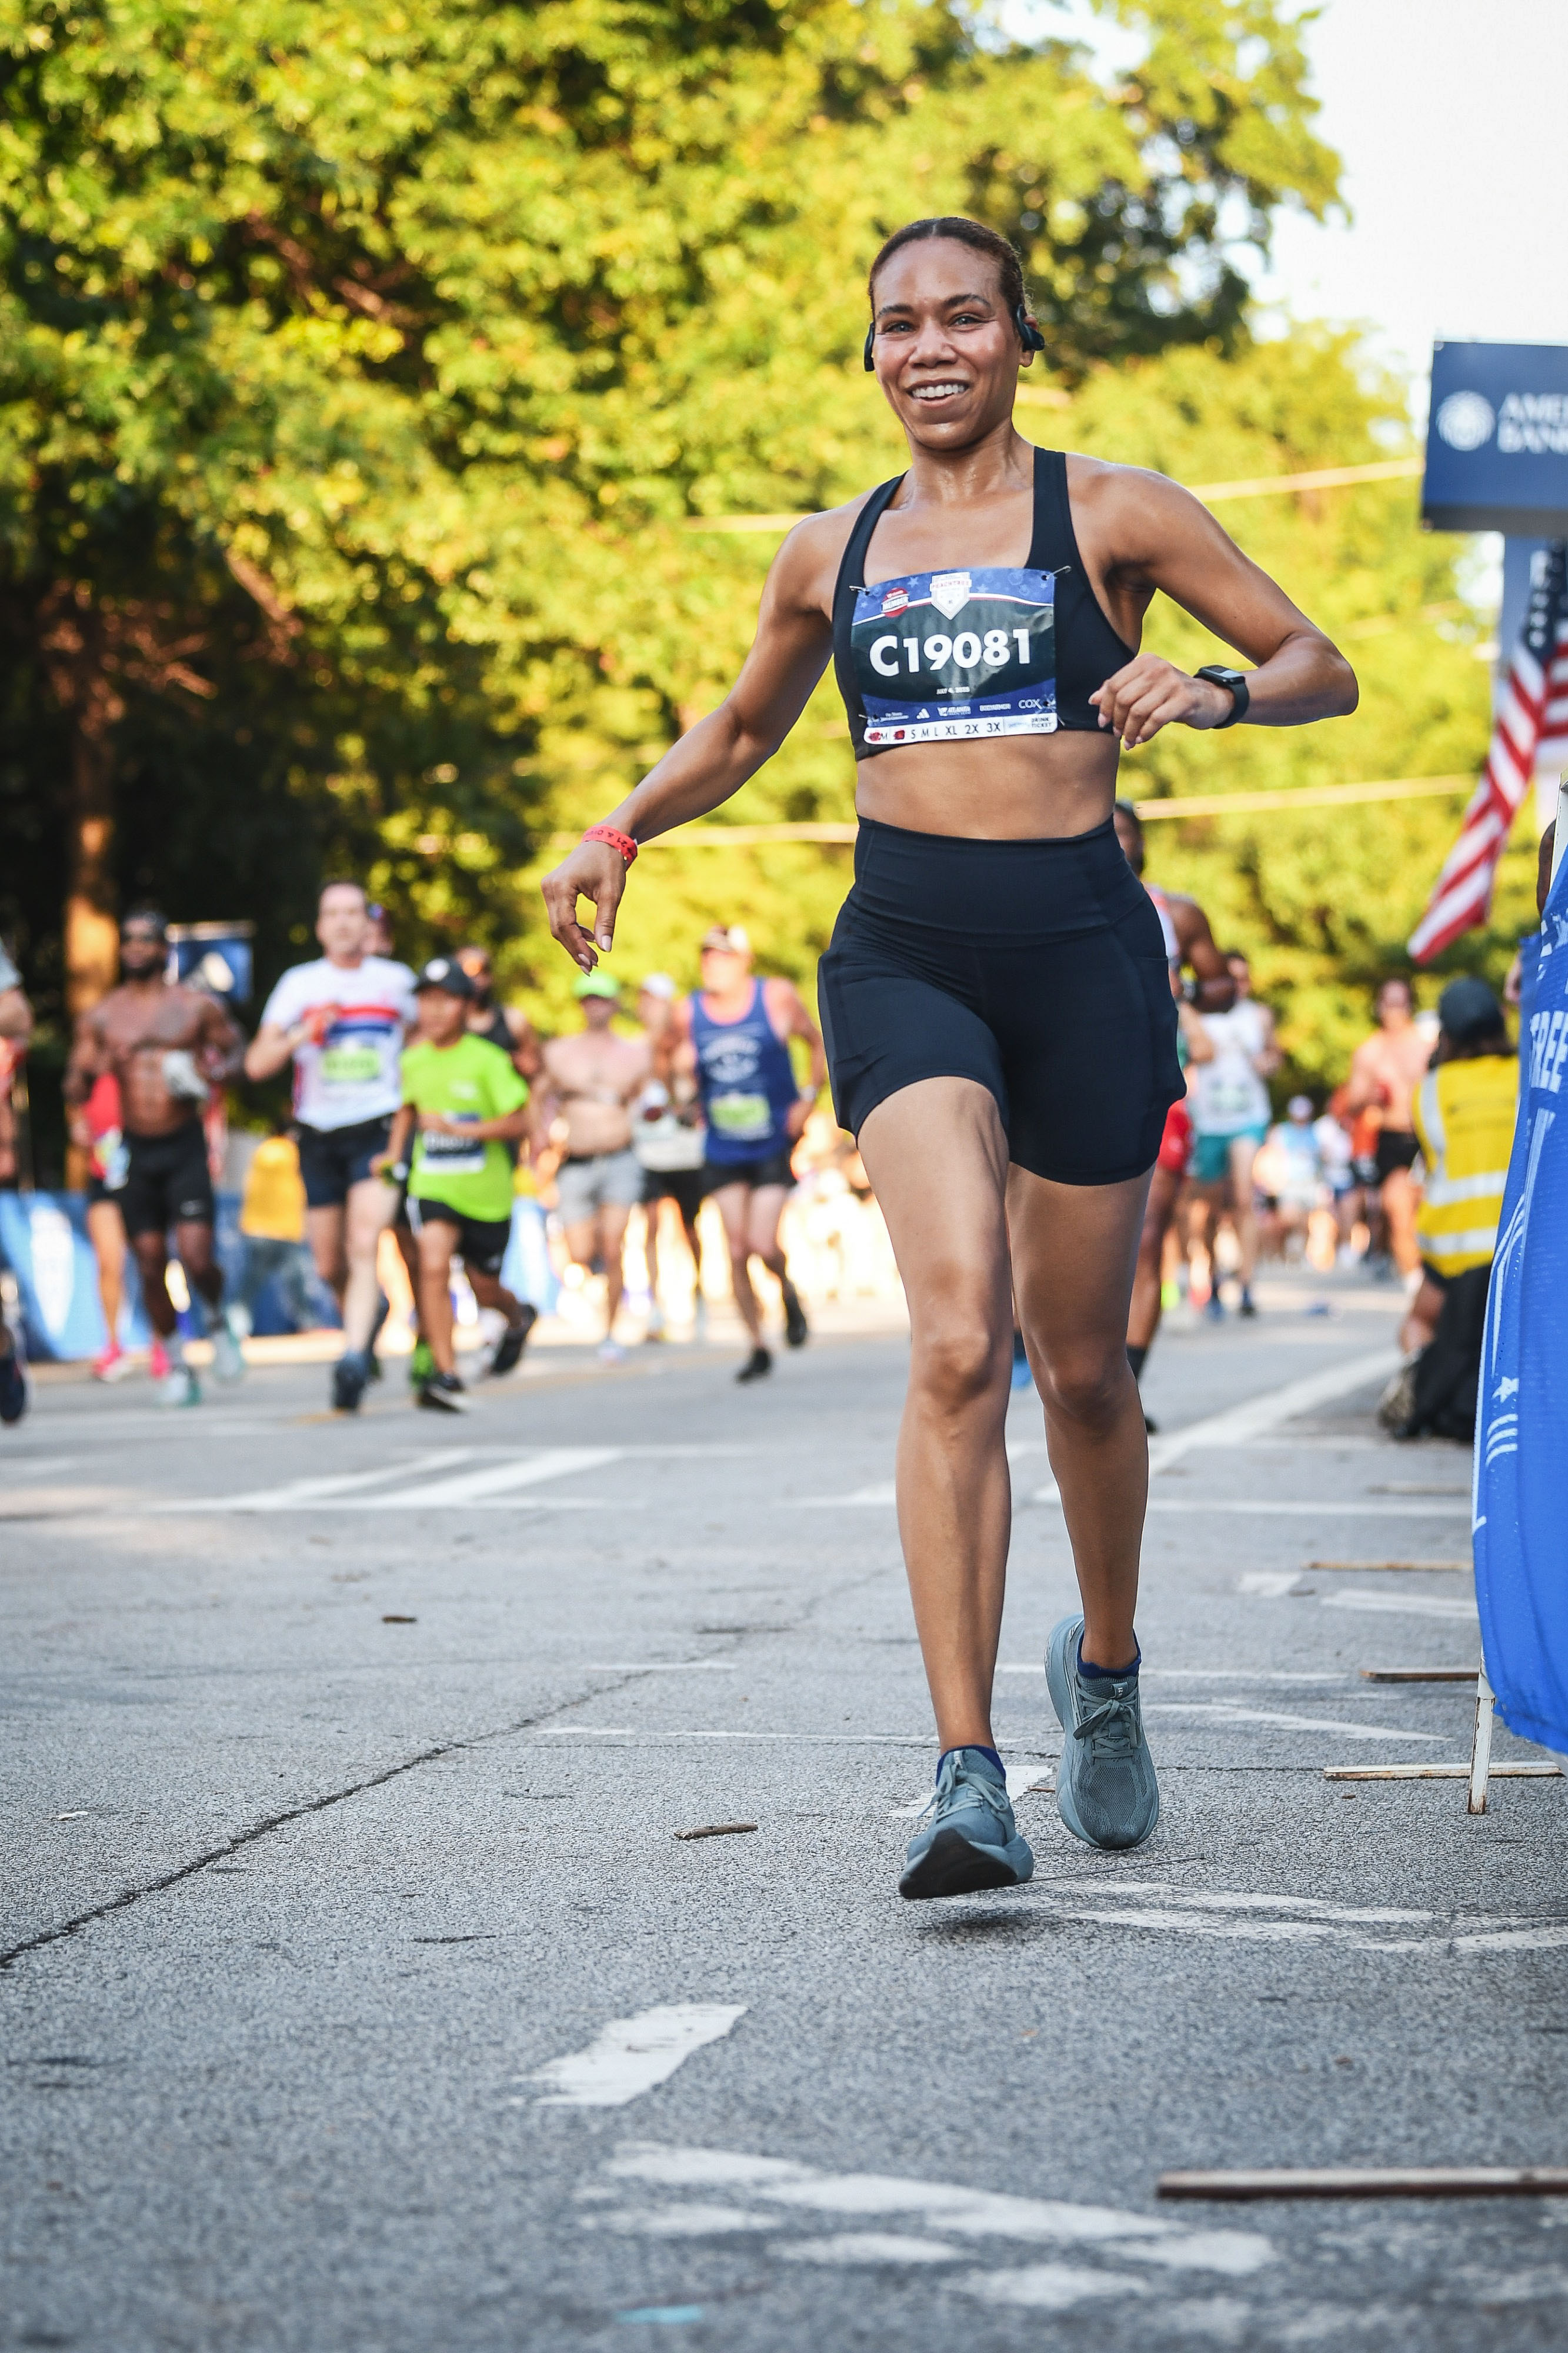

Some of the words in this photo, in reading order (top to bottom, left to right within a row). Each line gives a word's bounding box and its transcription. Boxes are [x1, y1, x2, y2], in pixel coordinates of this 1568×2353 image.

[869, 628, 1030, 677] C19081
[1018, 698, 1043, 709] COX
[911, 729, 916, 739] S
[921, 726, 930, 738] M
[934, 726, 939, 736] L
[945, 725, 958, 735] XL
[965, 724, 979, 734] 2X
[987, 722, 1001, 733] 3X
